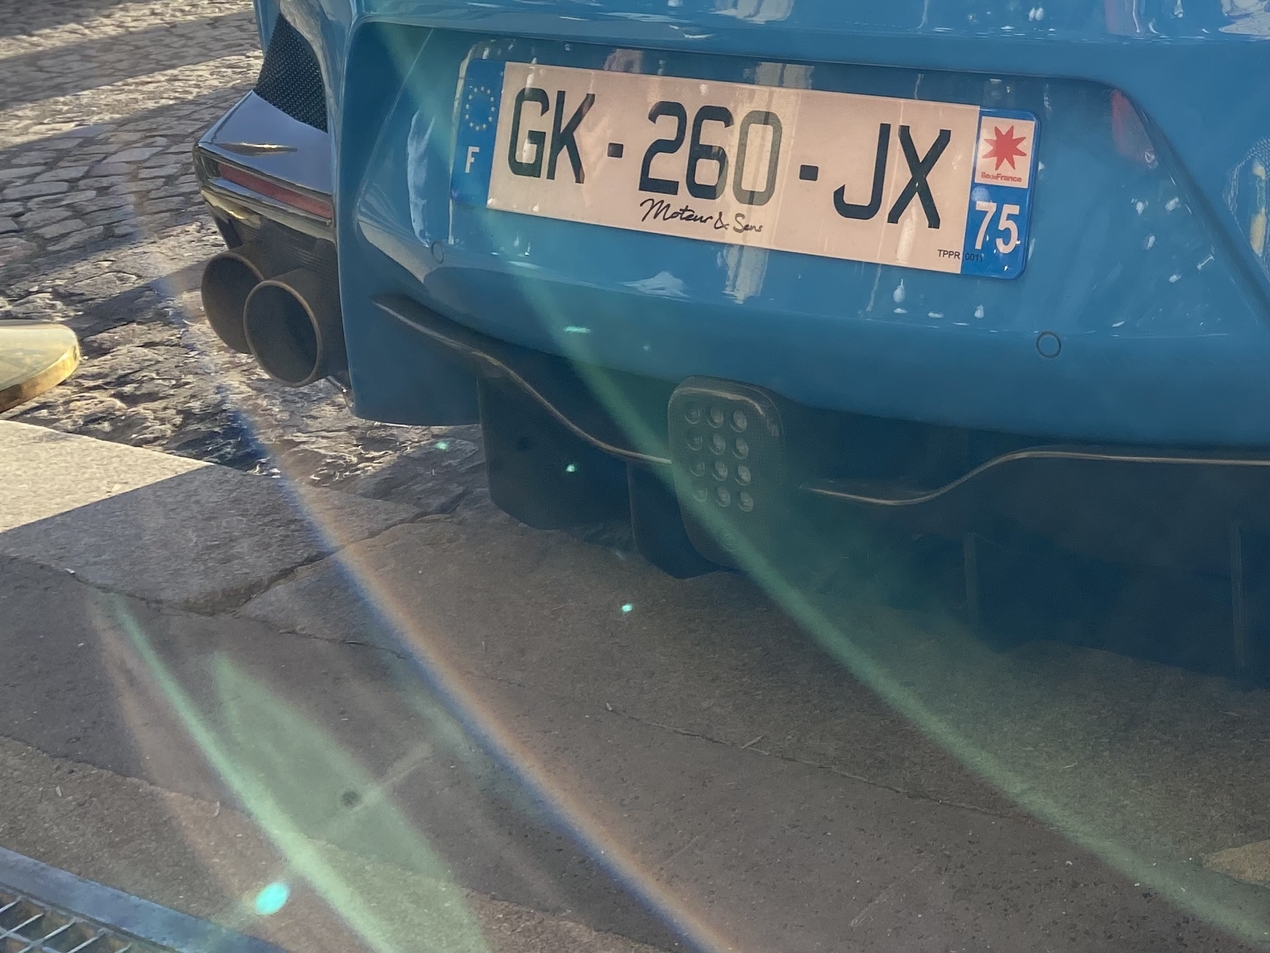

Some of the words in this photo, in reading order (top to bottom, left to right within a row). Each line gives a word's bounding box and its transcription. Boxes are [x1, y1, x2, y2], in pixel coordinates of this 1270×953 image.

[465, 145, 480, 174] F
[714, 211, 729, 231] &
[974, 200, 1020, 254] 75
[937, 249, 960, 259] TPPR
